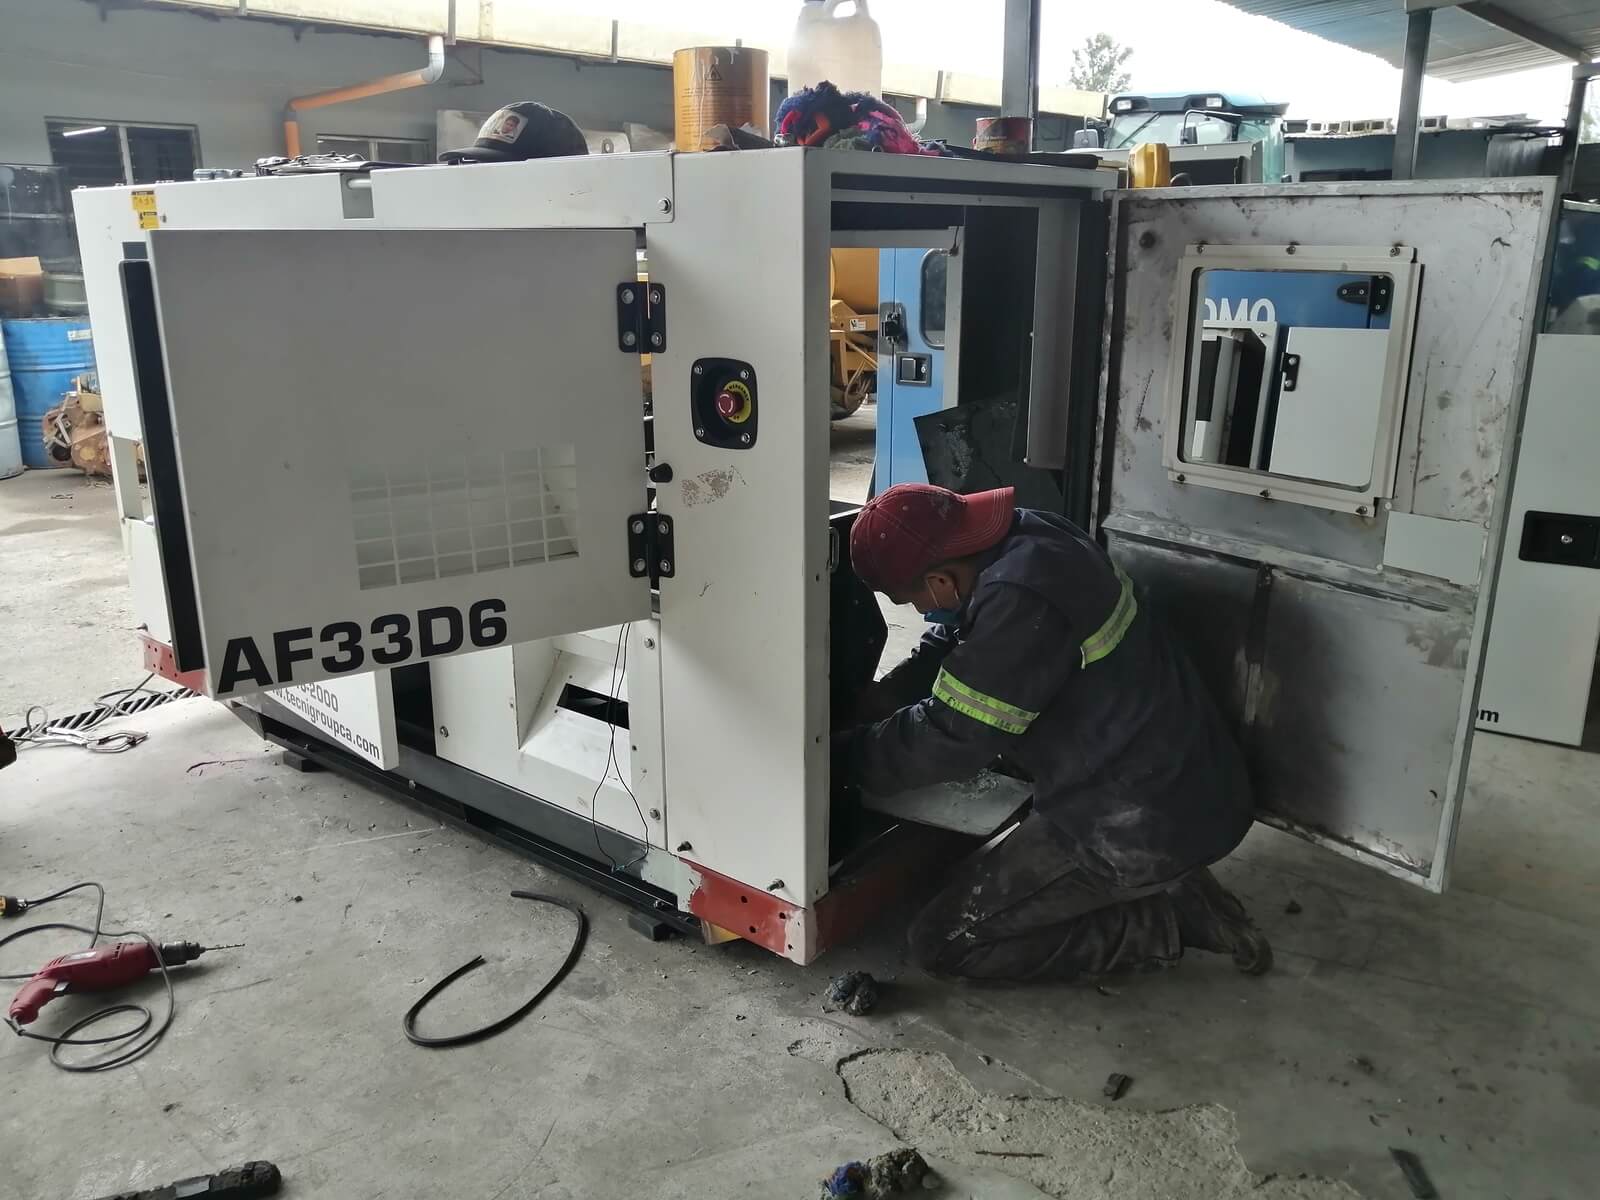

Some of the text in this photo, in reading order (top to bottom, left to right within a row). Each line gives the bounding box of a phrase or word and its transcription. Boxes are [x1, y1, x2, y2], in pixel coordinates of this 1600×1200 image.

[217, 598, 507, 694] AF33D6
[272, 687, 380, 760] w.tecnigroupca.com
[1476, 709, 1499, 723] m
